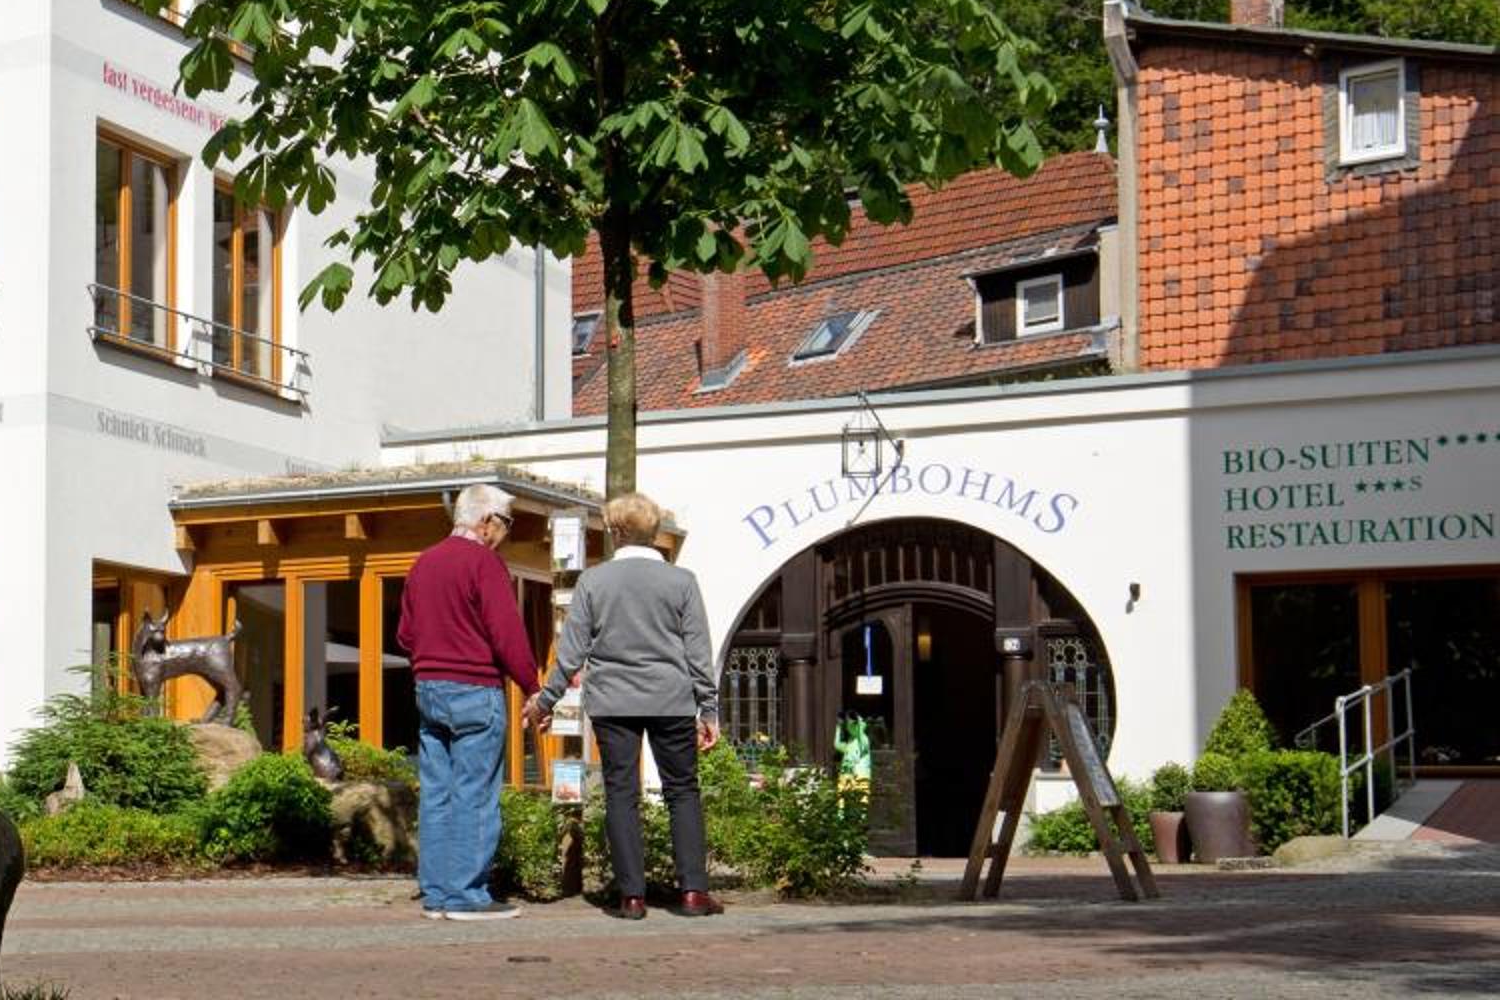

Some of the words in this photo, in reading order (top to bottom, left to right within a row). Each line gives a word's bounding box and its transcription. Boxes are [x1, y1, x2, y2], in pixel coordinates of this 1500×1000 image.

[102, 60, 128, 92] fast
[131, 78, 205, 123] vergessene
[1222, 438, 1431, 475] BIO-SUITEN
[1224, 483, 1345, 512] HOTEL
[1225, 512, 1496, 549] RESTAURATION
